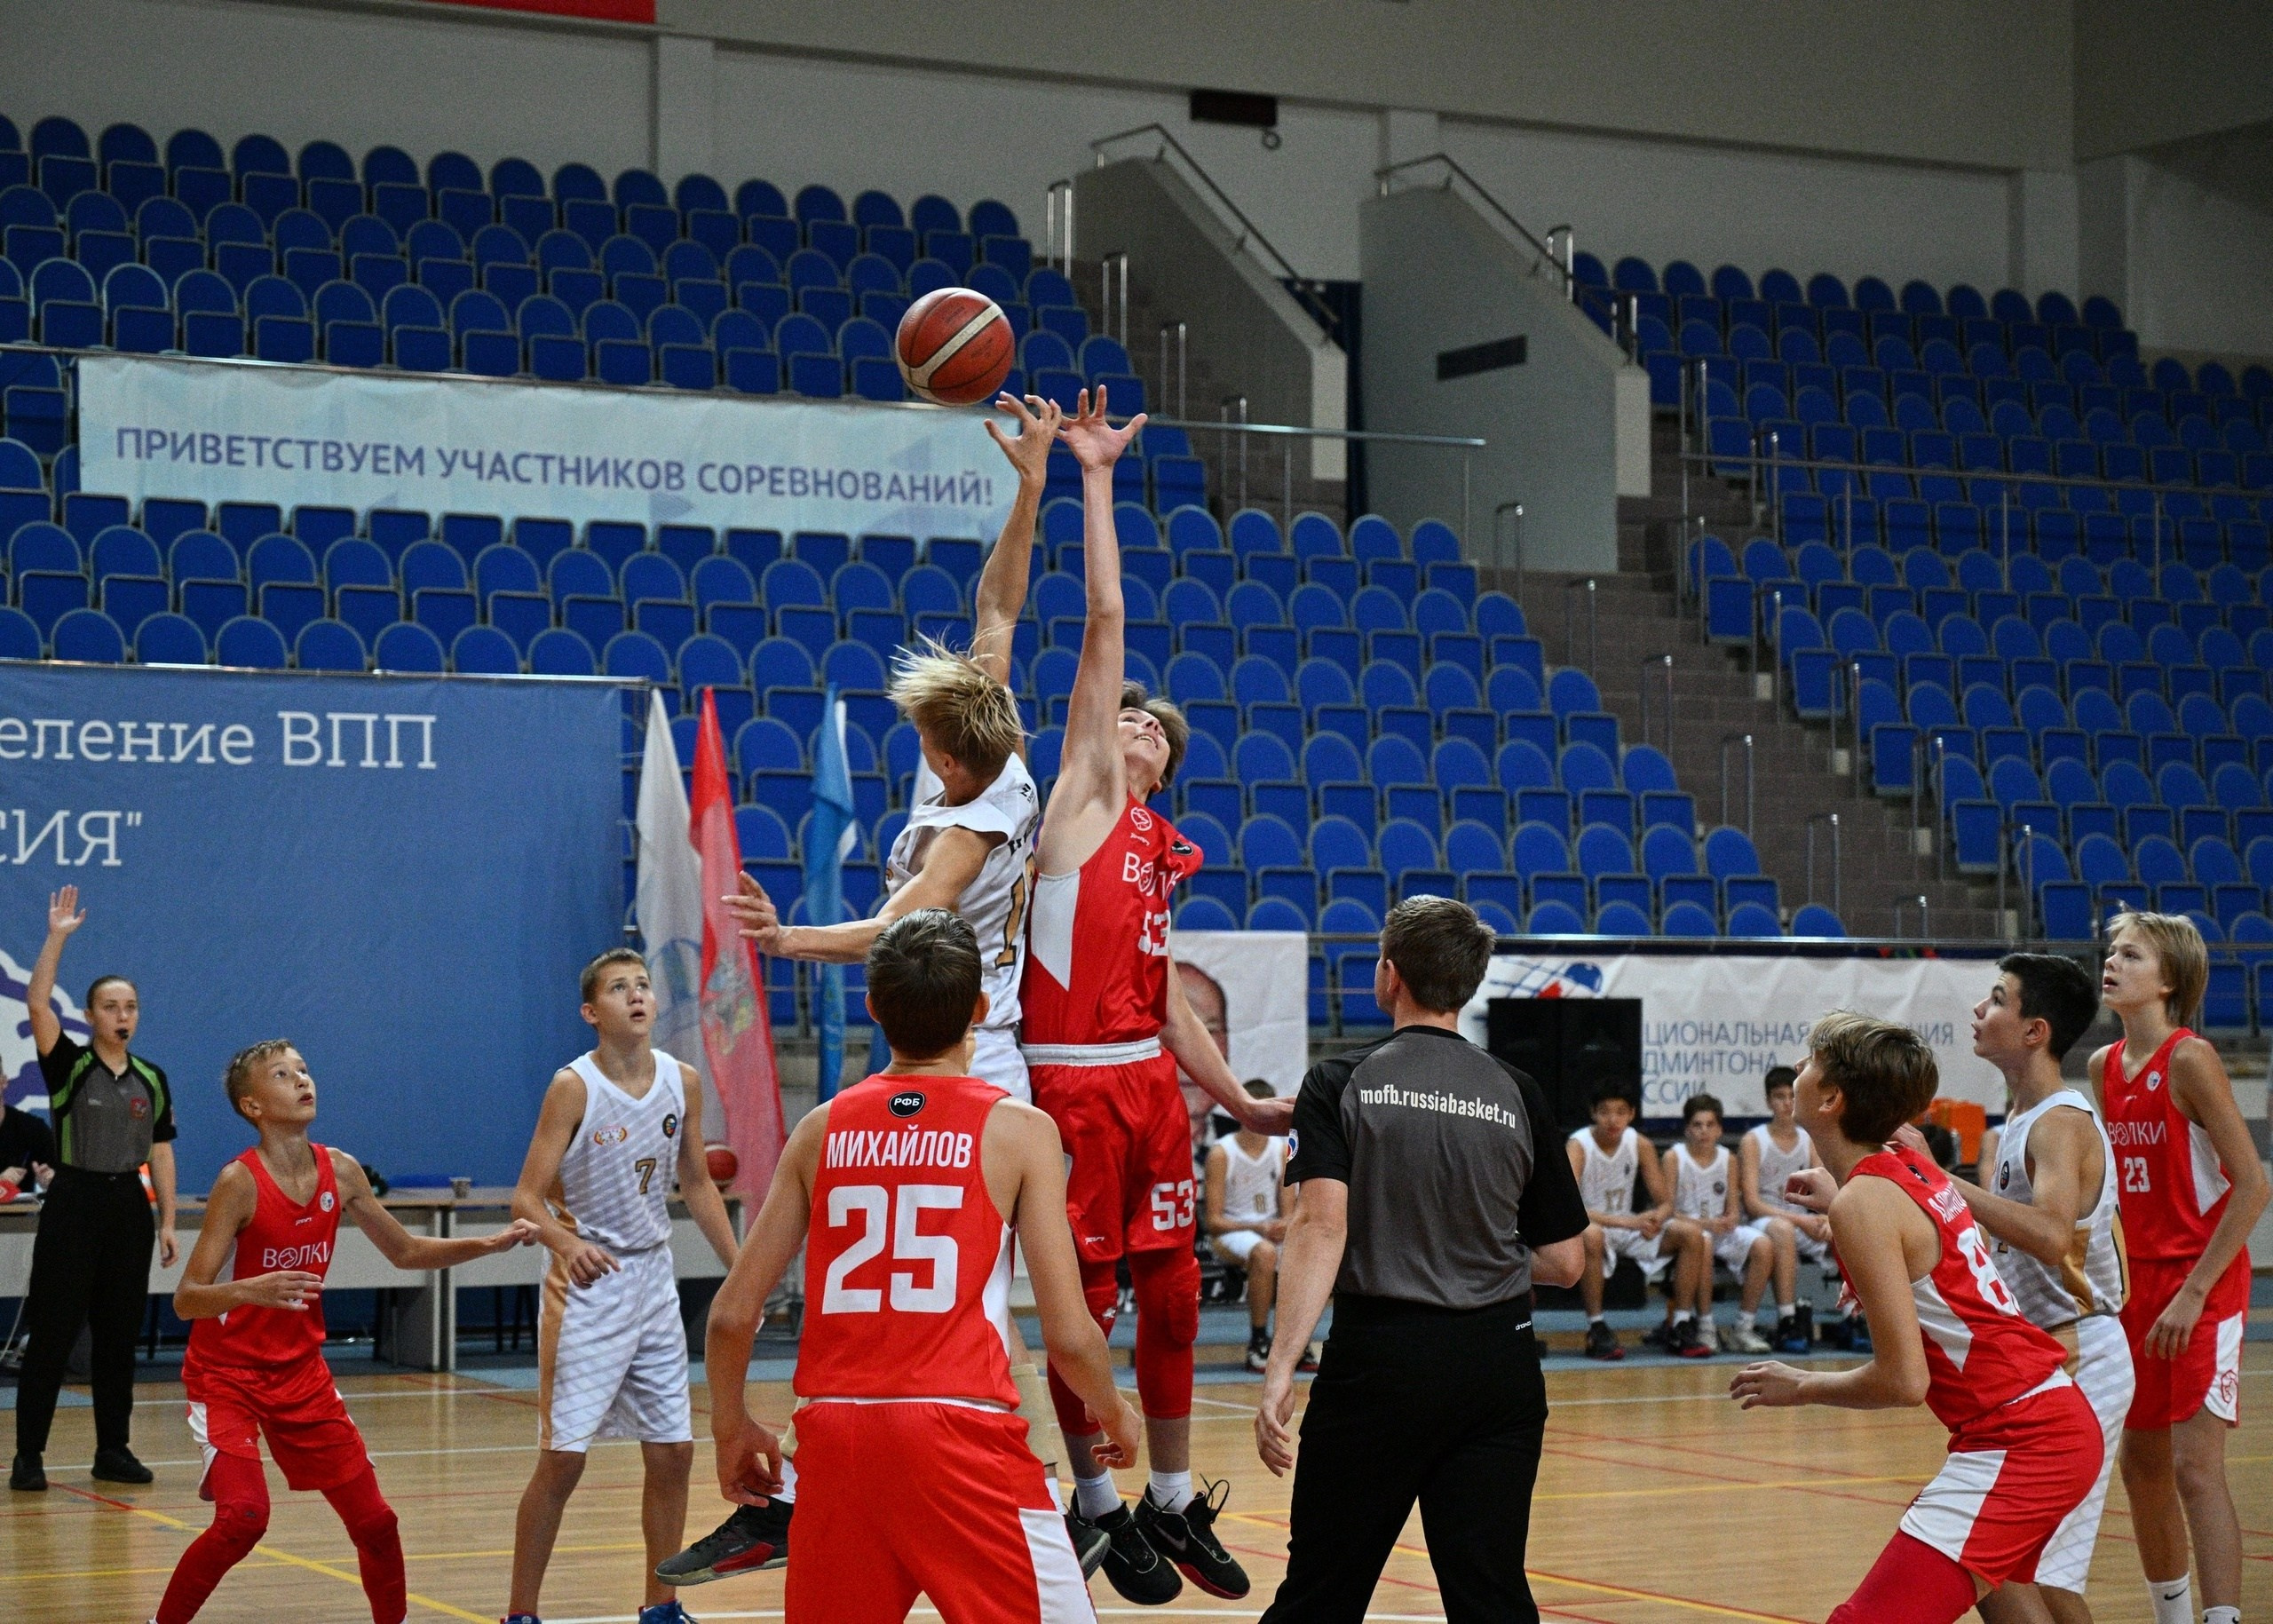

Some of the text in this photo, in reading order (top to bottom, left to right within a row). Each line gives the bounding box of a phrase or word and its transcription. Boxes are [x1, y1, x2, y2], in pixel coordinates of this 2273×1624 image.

[116, 427, 993, 506] ПРИВЕТСТВУЕМ УЧАСТНИКОВ СОРЕВНОВАНИЙ!
[278, 711, 438, 769] ВПП
[0, 808, 143, 867] ИЯ"
[894, 1097, 921, 1107] РФБ
[1360, 1083, 1517, 1129] mofb.russiabasket.ru
[826, 1124, 973, 1169] МИХАЙЛОВ
[2108, 1121, 2166, 1146] ВОЛКИ
[635, 1158, 656, 1195] 7
[2124, 1156, 2150, 1192] 23
[1151, 1179, 1194, 1232] 53
[821, 1184, 964, 1314] 25
